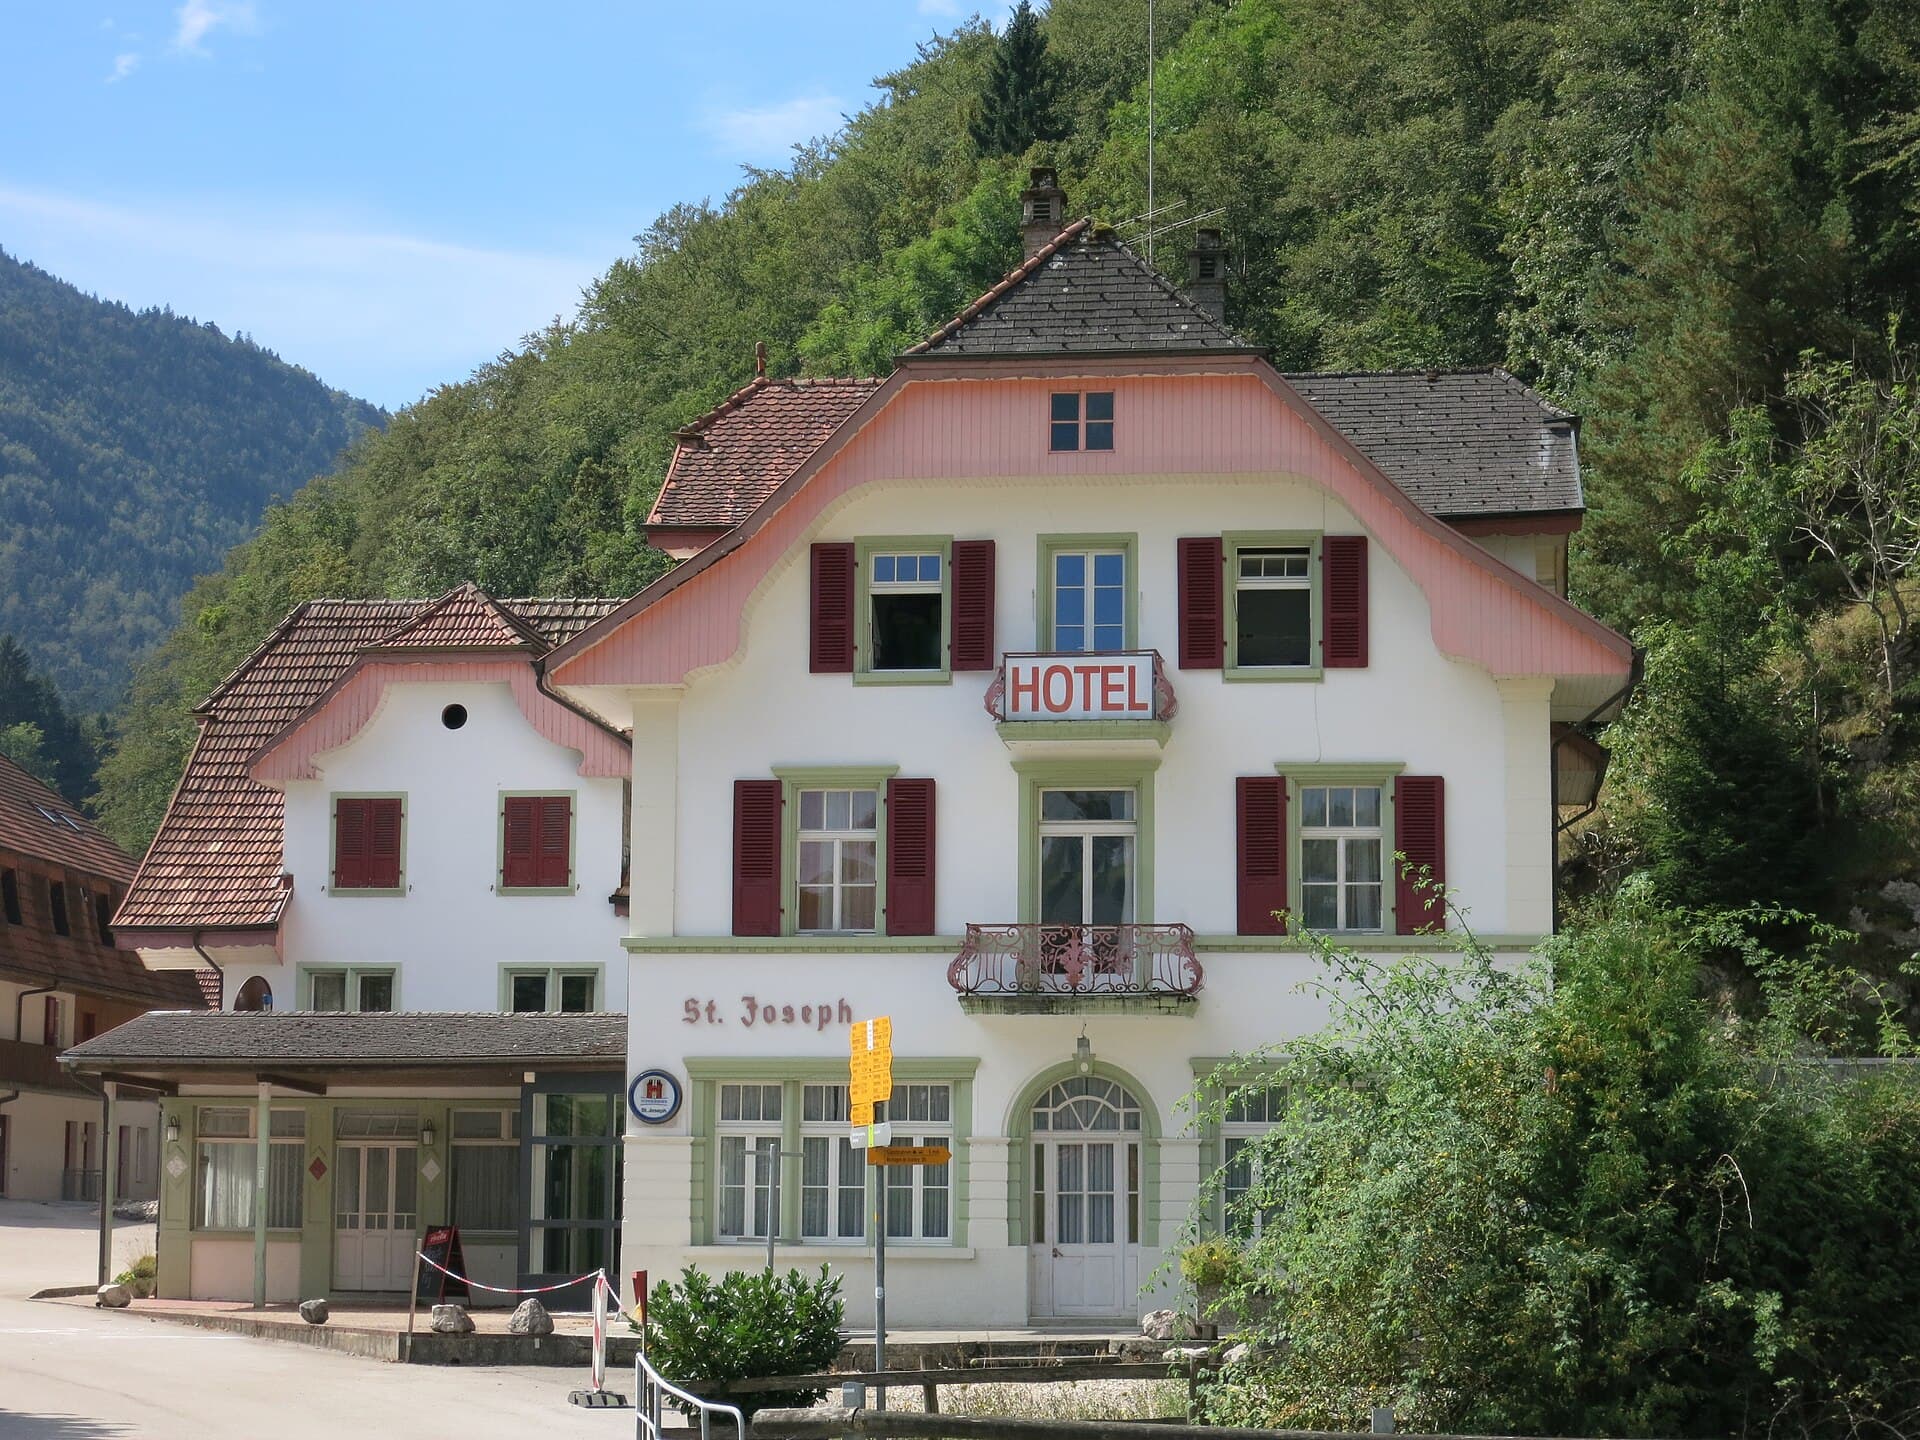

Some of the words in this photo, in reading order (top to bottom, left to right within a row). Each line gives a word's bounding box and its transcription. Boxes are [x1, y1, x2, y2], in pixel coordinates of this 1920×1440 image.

[1011, 664, 1149, 713] HOTEL
[682, 998, 723, 1024] St.
[741, 996, 852, 1031] Joseph
